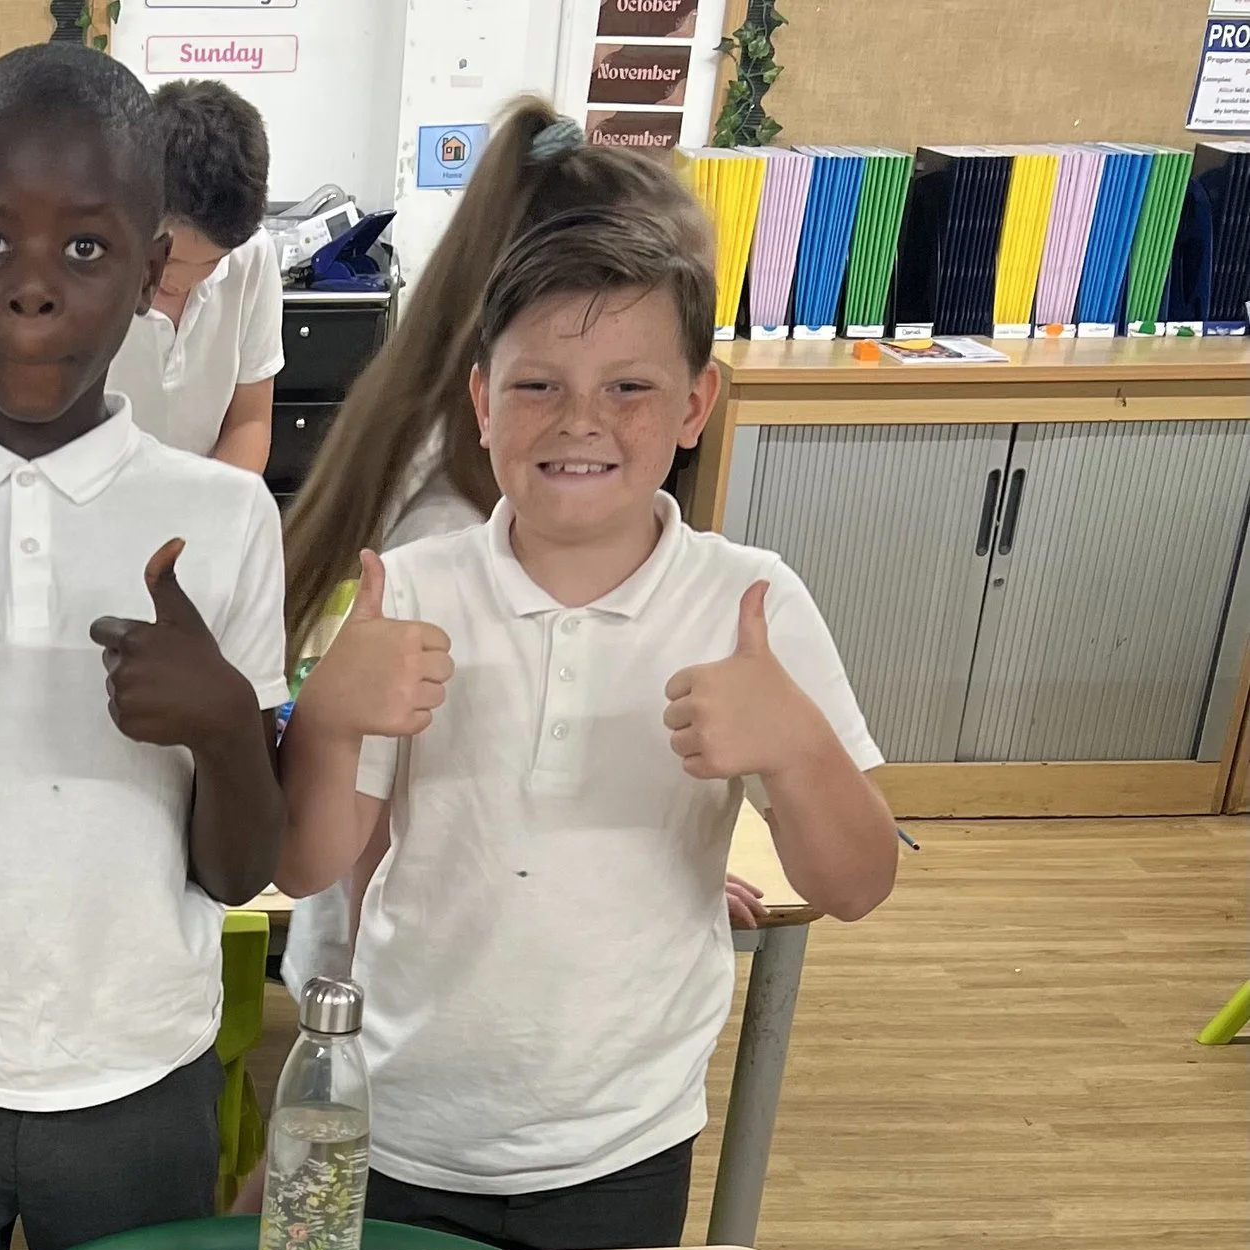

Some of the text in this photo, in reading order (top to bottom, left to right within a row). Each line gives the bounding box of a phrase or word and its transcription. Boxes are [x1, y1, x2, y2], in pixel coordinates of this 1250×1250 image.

[616, 0, 681, 12] October
[180, 41, 263, 69] Sunday
[597, 63, 681, 81] November
[592, 129, 671, 146] December
